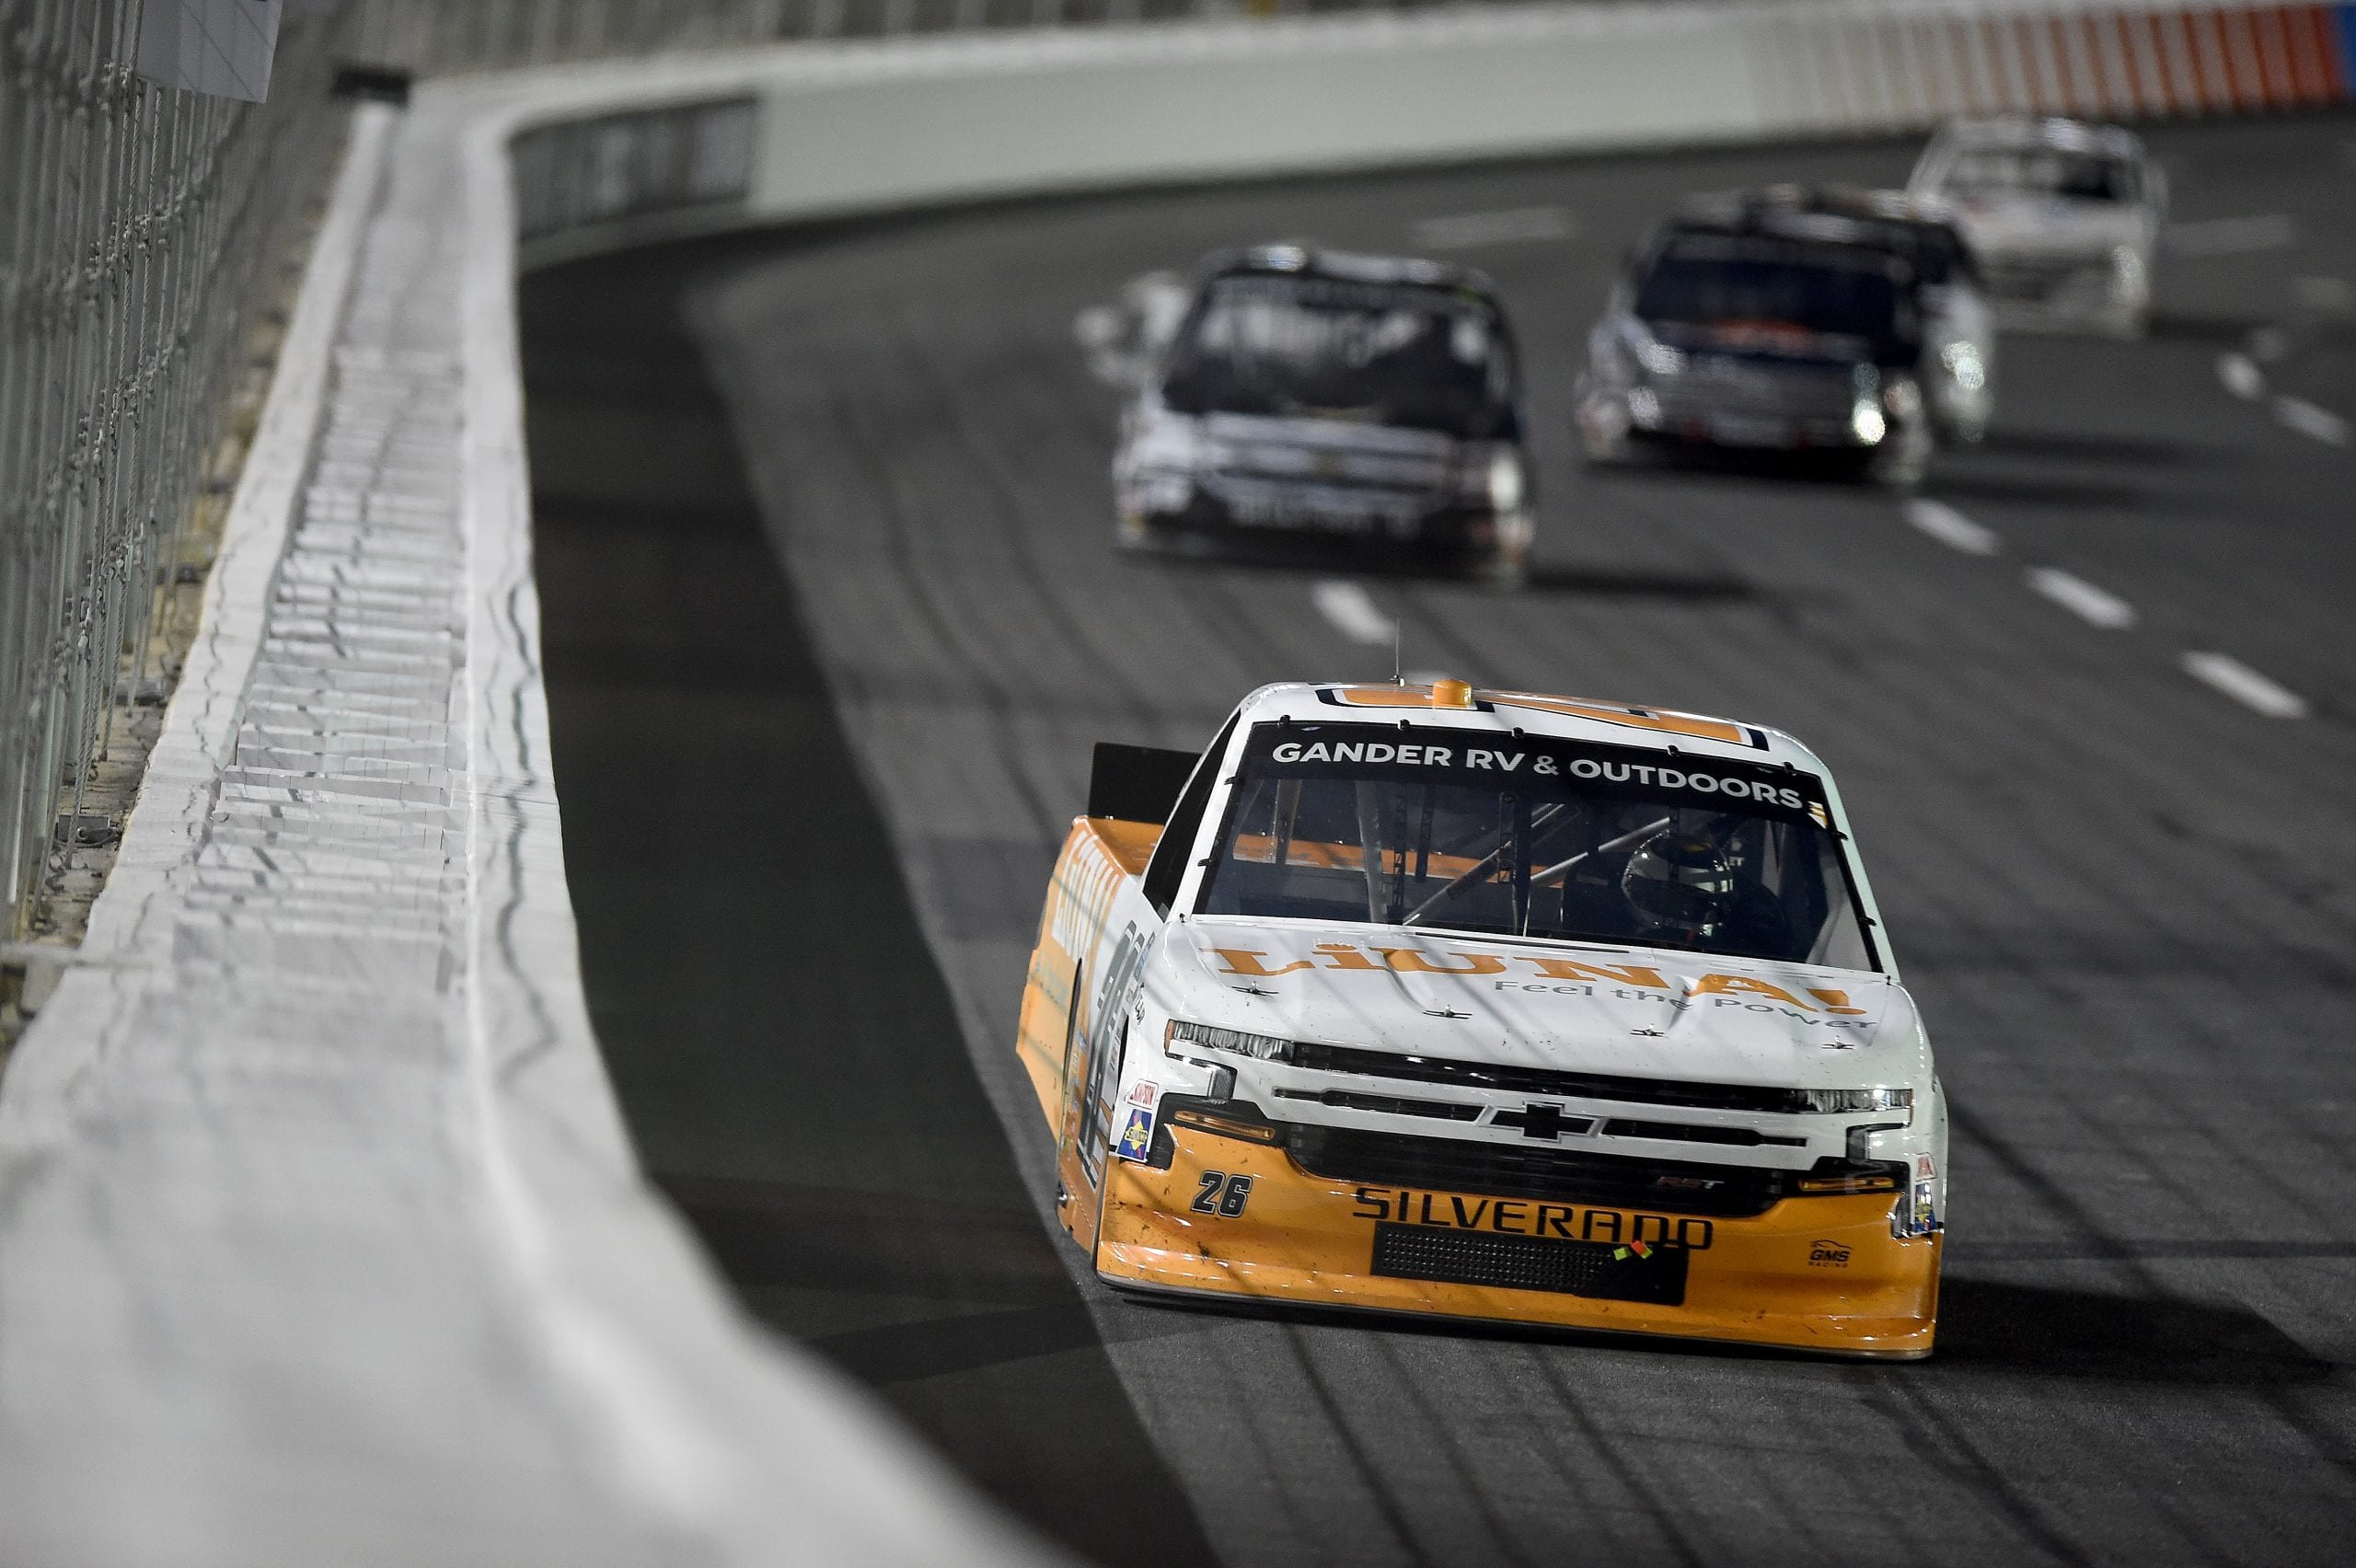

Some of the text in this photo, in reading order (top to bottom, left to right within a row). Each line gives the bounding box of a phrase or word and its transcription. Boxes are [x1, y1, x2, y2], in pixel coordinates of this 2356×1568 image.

[1272, 742, 1804, 809] GANDER RV & OUTDOORS
[1496, 981, 1593, 996] Feel
[1611, 989, 1694, 1011] the
[1191, 1170, 1253, 1218] 26
[1353, 1186, 1714, 1251] SILVERADO
[1809, 1249, 1851, 1262] GMS
